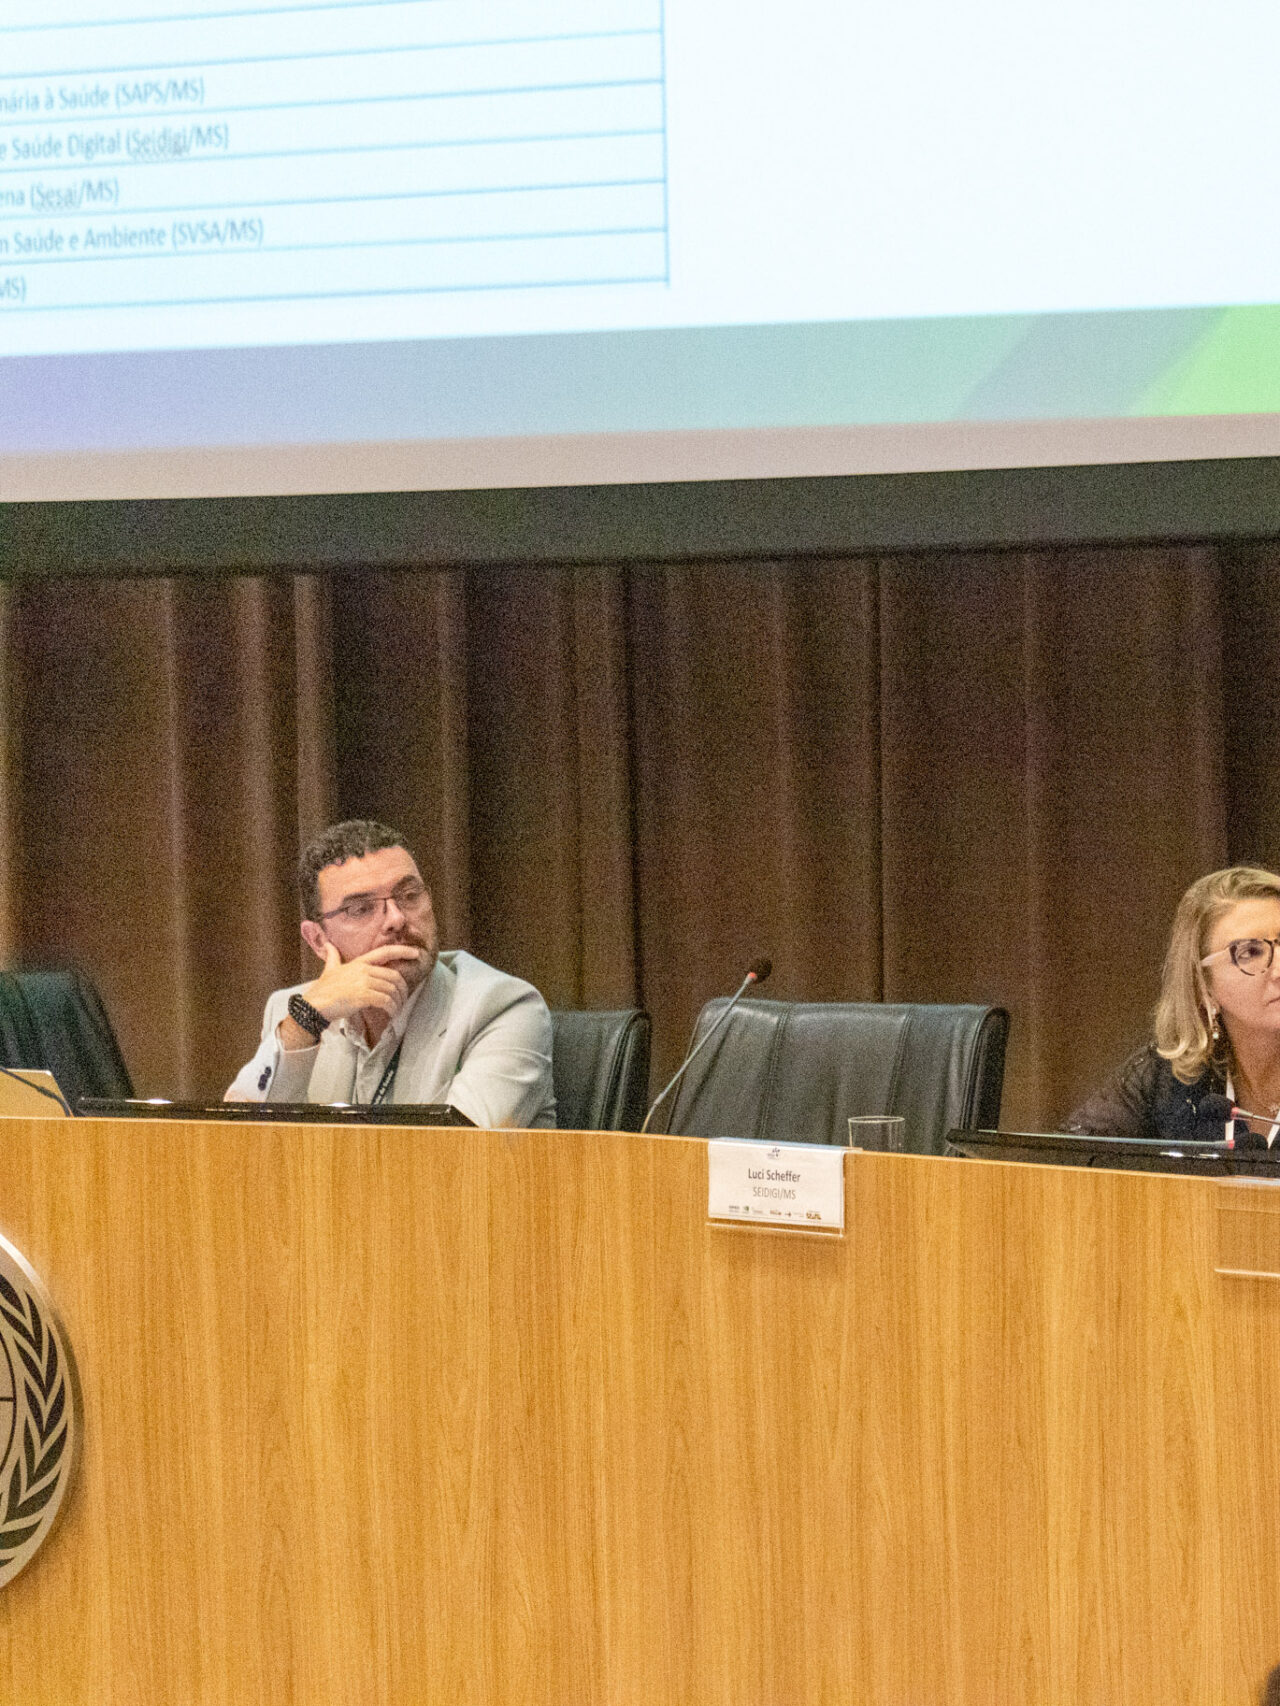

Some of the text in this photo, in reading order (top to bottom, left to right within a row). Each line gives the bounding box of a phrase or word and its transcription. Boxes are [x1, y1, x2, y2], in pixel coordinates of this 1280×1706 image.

[59, 84, 110, 111] Saúde
[115, 76, 205, 109] (SAPS/MS)
[12, 132, 62, 160] Saúde
[68, 129, 121, 161] Digital
[126, 123, 229, 158] (Seidigi/MS)
[30, 177, 120, 208] (Sesai/MS)
[13, 228, 64, 254] Saúde
[69, 233, 80, 250] e
[84, 224, 166, 250] Ambiente
[171, 218, 264, 250] (SVSA/MS)
[748, 1168, 801, 1182] Luci Scheffer
[753, 1186, 796, 1200] SEIDIGI/MS
